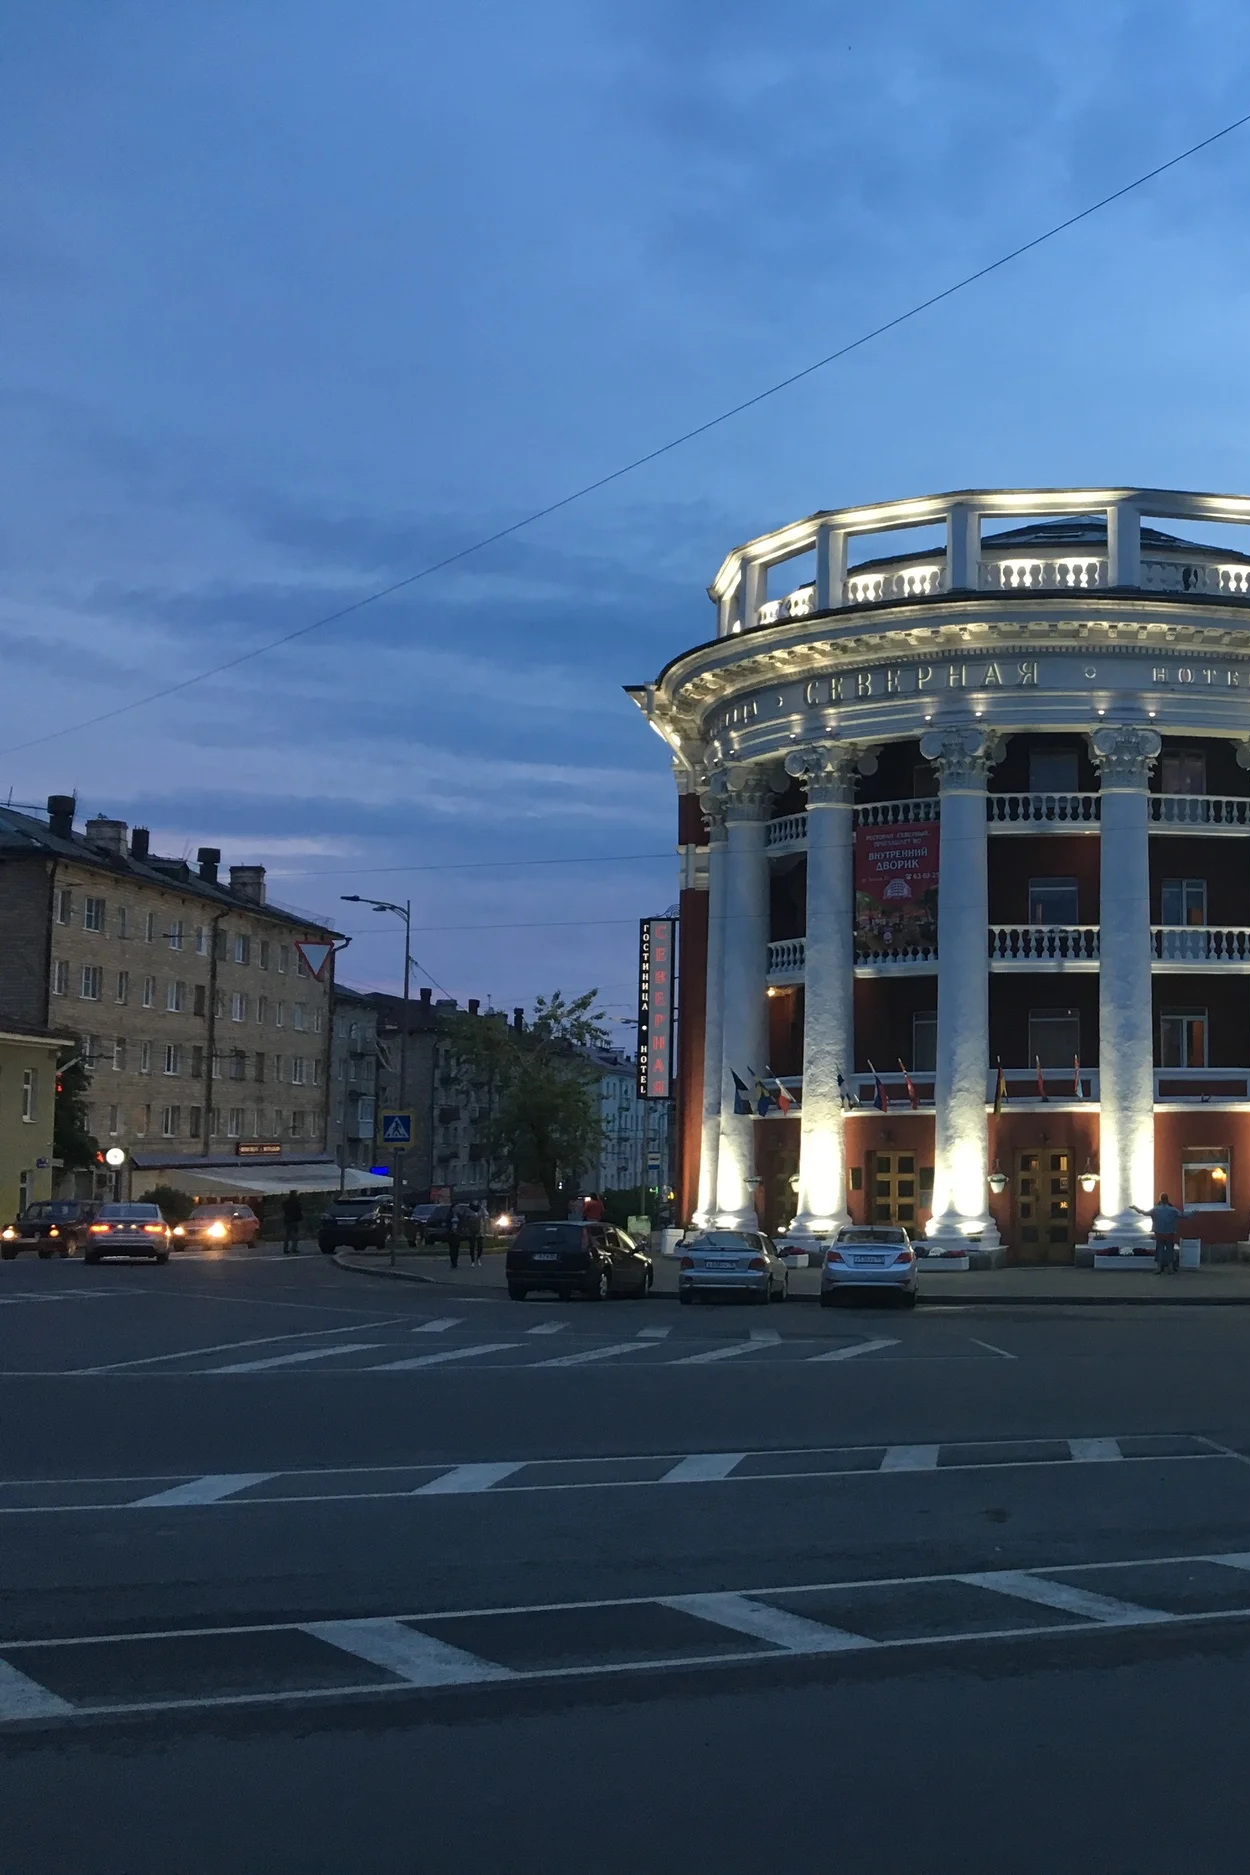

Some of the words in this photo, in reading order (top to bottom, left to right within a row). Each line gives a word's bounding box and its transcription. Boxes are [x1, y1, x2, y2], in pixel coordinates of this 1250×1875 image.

[806, 661, 1038, 705] СЕВЕРНАЯ
[868, 847, 927, 860] ВНУТРЕННИЙ
[876, 859, 919, 871] ДВОРИК
[642, 924, 650, 1011] ГОСТИНИЦА
[653, 924, 667, 1094] СЕВЕРНАЯ
[640, 1045, 648, 1094] HOTEL
